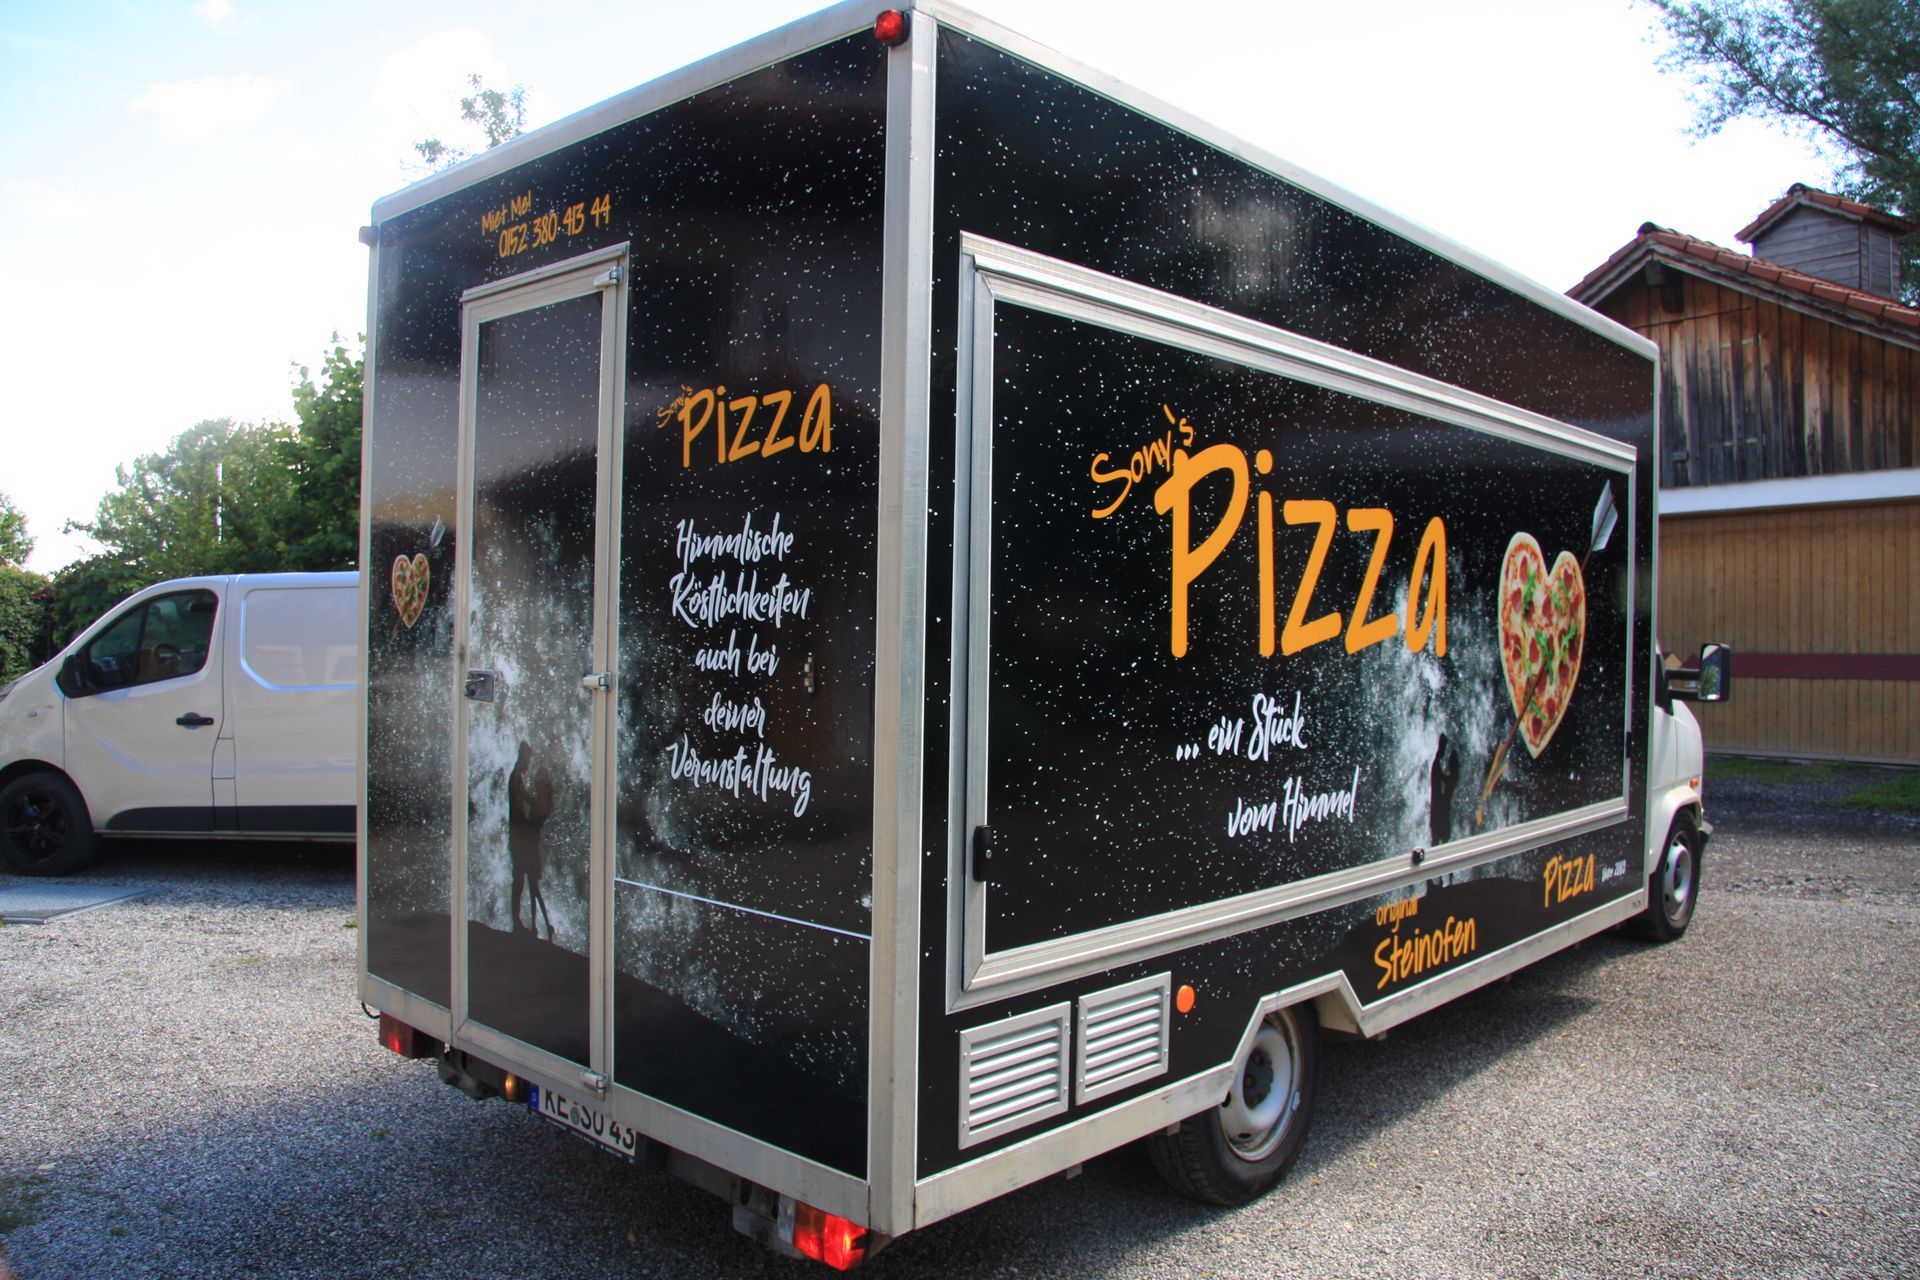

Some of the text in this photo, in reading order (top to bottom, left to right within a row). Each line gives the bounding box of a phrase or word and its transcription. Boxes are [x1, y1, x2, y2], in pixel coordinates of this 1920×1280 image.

[482, 189, 531, 236] Miet Me!
[499, 193, 611, 257] 0152 380 413 44
[677, 383, 831, 468] Pizza
[676, 511, 794, 573] Himmlische
[1154, 443, 1447, 658] Pizza
[669, 570, 811, 628] Köstlichkeiten
[695, 629, 779, 677] auch bei
[704, 692, 765, 738] deiner
[1208, 716, 1245, 756] ein
[1248, 690, 1308, 762] Stück
[666, 732, 811, 817] Veranstaltung
[1283, 765, 1359, 844] Himmel
[1543, 853, 1596, 908] Pizza
[1376, 894, 1420, 935] original
[1374, 916, 1476, 990] Steinofen
